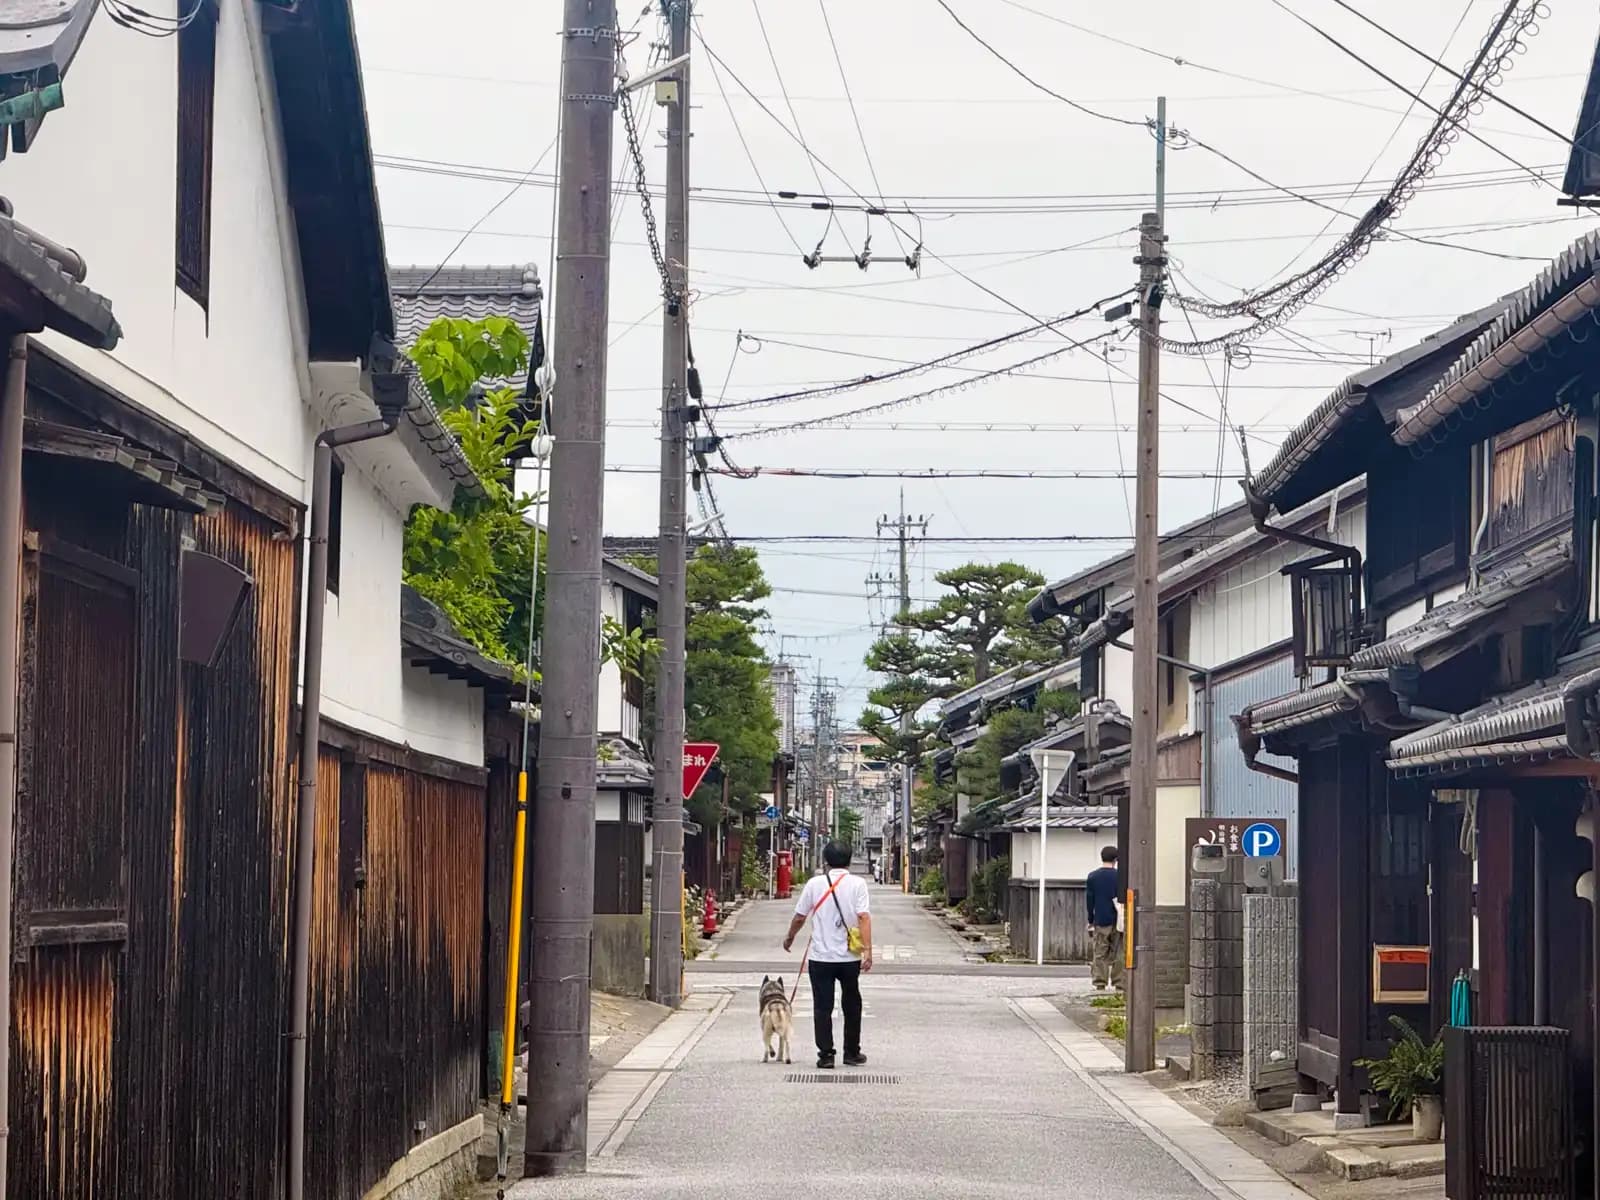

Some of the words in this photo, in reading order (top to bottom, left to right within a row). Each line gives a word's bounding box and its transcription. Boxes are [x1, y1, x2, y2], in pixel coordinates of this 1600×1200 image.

[682, 754, 706, 767] まれ
[1229, 824, 1240, 852] お食事
[1252, 830, 1274, 857] P
